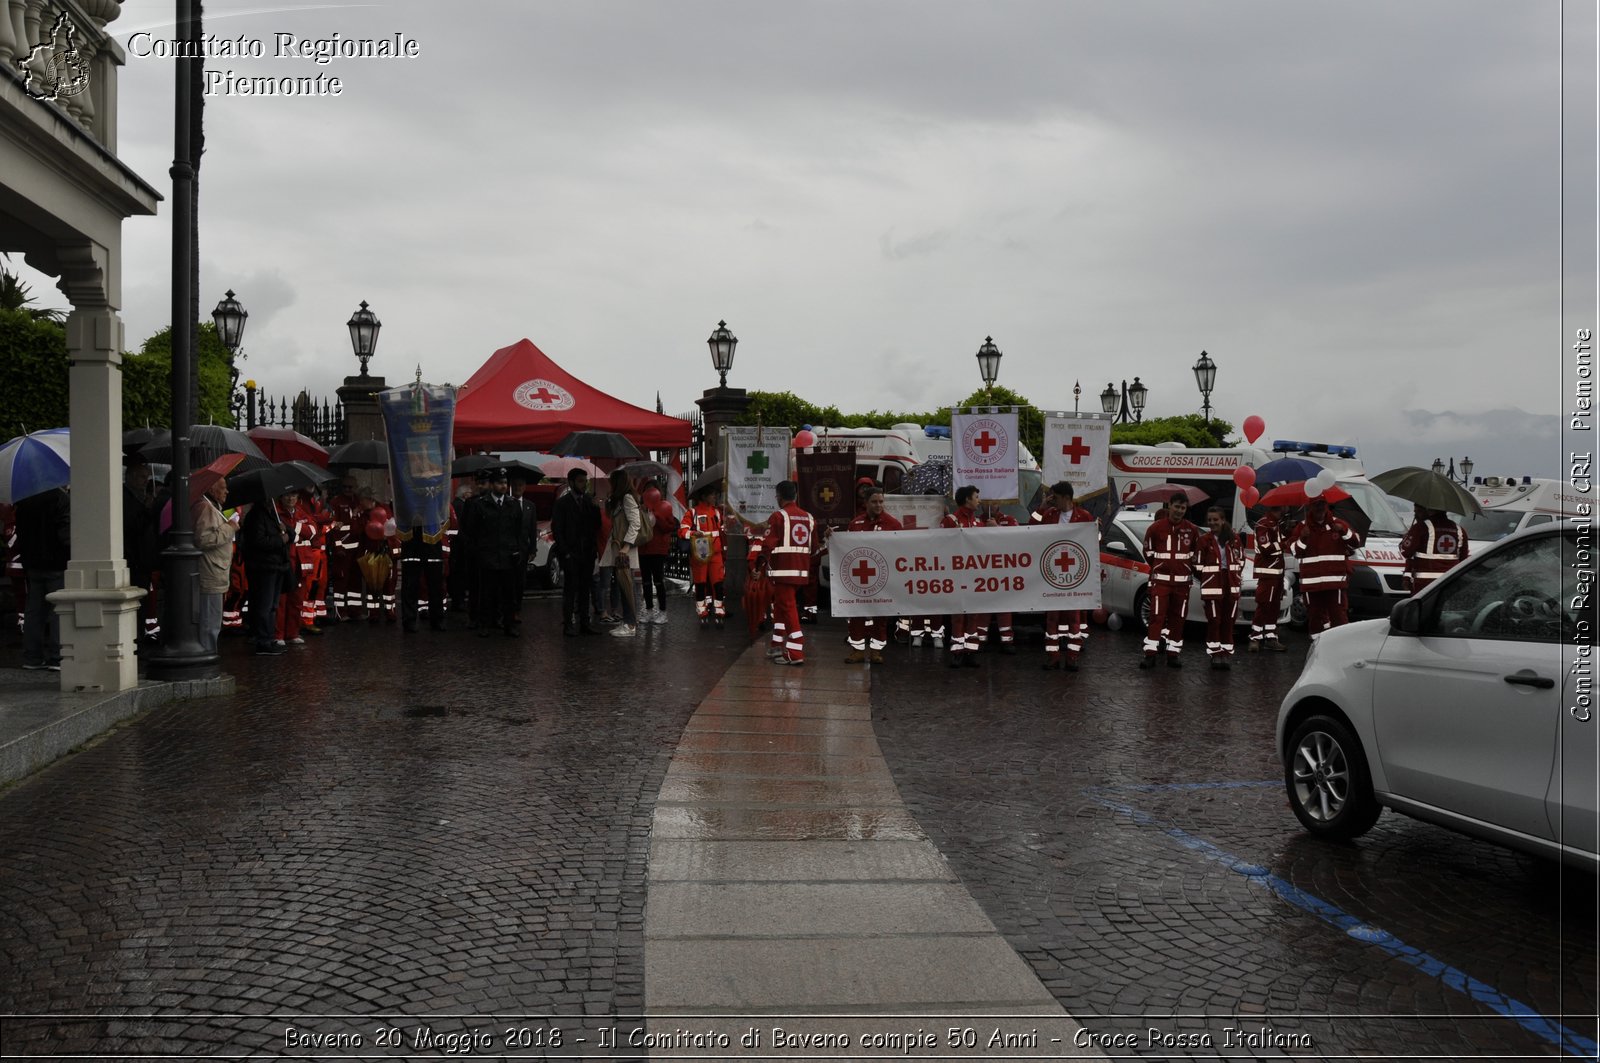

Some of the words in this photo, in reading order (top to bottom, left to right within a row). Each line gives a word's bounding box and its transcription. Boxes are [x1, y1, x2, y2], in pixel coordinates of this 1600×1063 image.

[1132, 456, 1162, 466] CROCE
[1163, 456, 1194, 466] ROSSA
[1196, 457, 1238, 466] ITALIANA
[1554, 494, 1574, 502] CROCE
[1575, 496, 1594, 504] ROSSA
[895, 556, 945, 572] C.R.I.
[952, 553, 1032, 570] BAVENO
[1058, 573, 1072, 584] 50
[904, 579, 954, 594] 1968
[974, 576, 1024, 592] 2018
